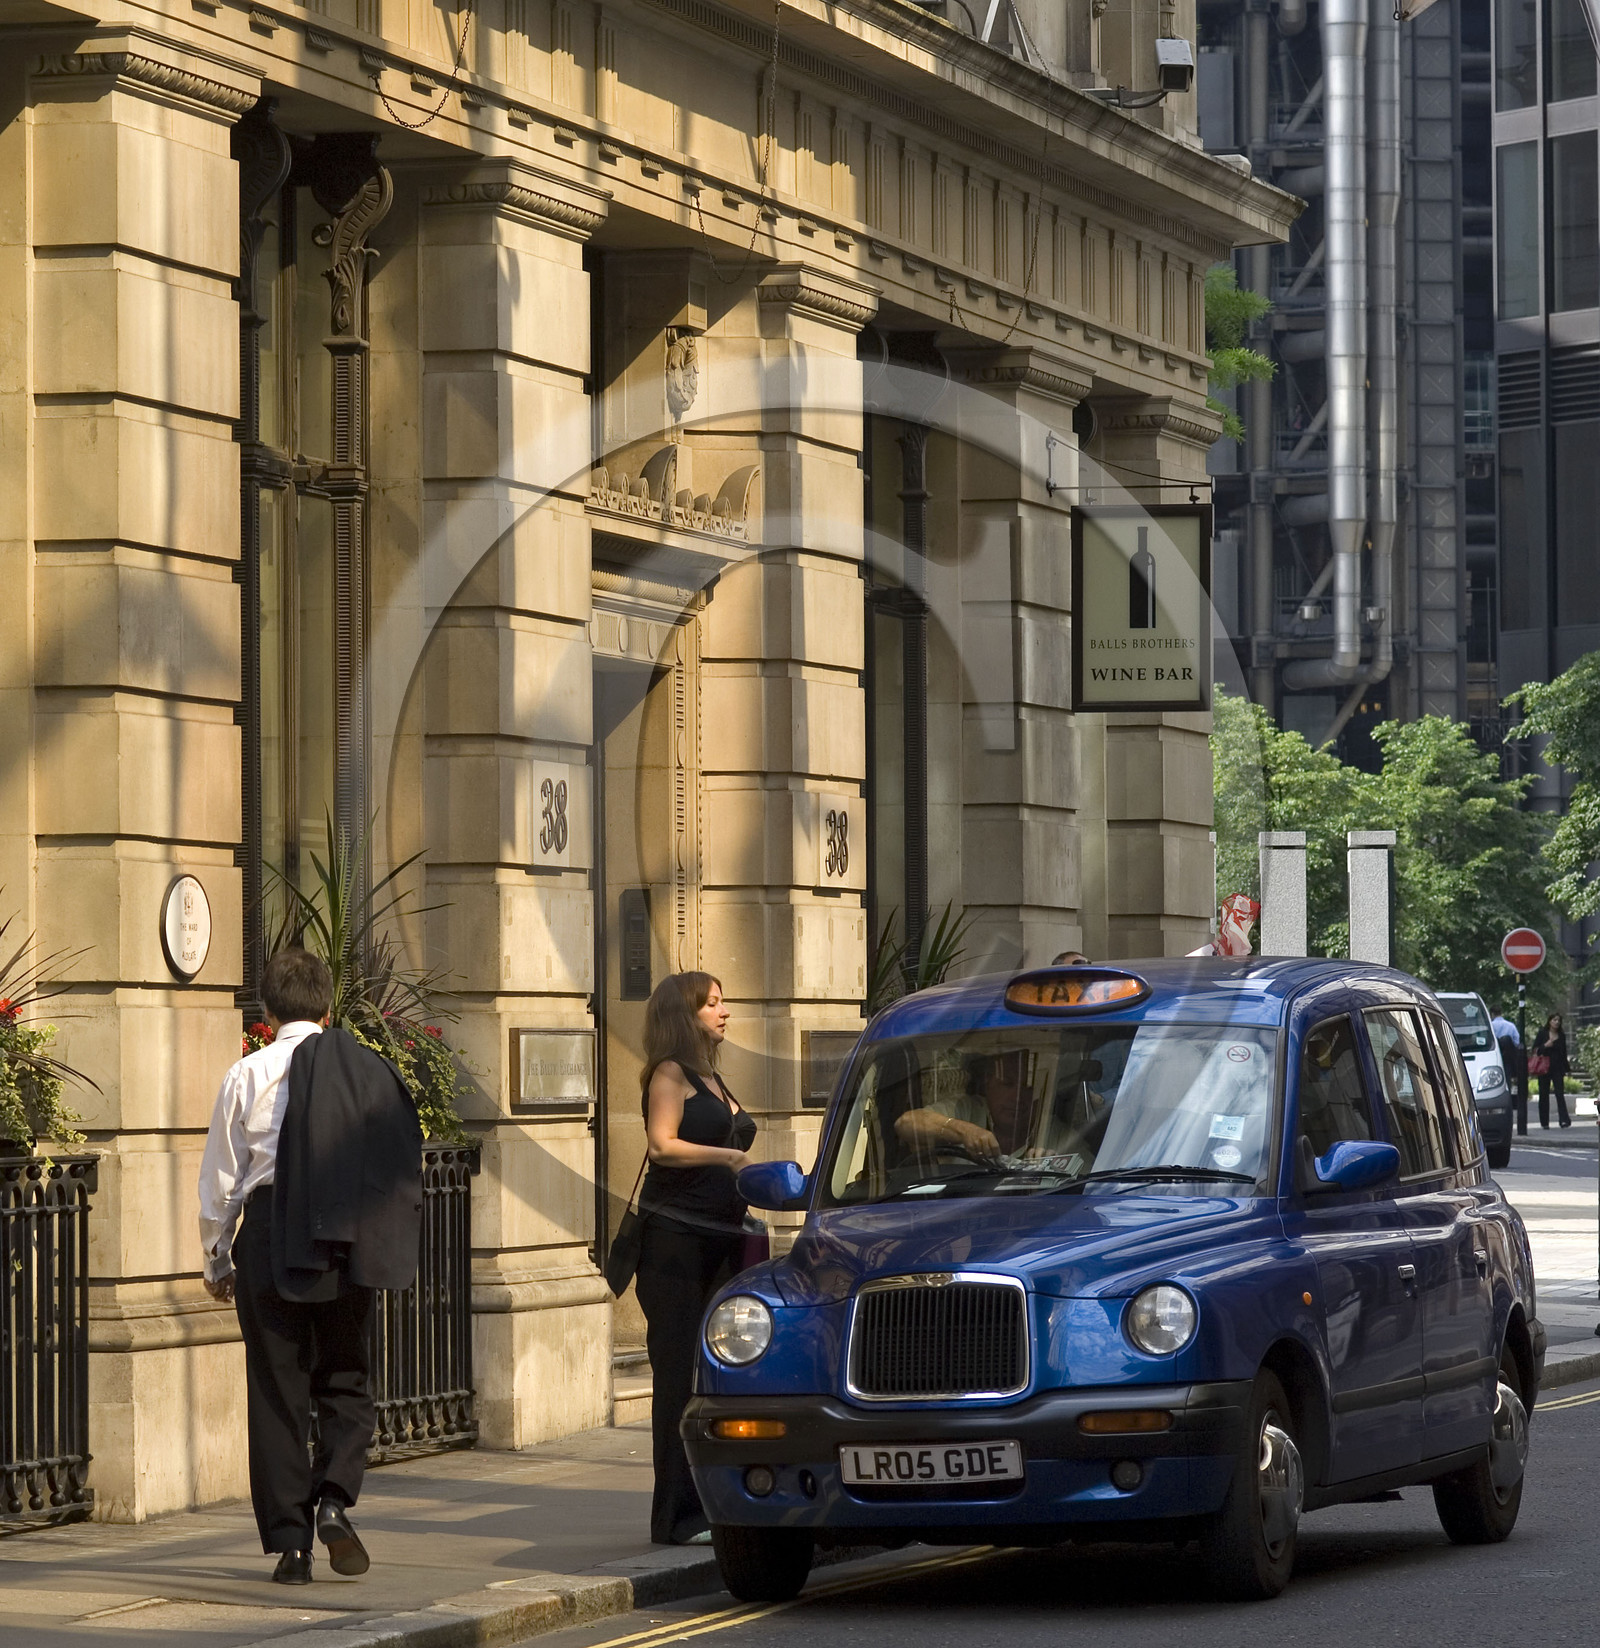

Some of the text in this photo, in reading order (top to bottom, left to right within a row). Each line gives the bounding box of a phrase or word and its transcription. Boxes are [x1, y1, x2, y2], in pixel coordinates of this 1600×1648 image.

[1091, 639, 1195, 649] BALLS BROTHERS
[1091, 668, 1194, 681] WINE BAR
[540, 777, 568, 854] 38
[825, 809, 849, 877] 38
[188, 923, 198, 931] WARD
[1033, 979, 1112, 1003] TAXI
[854, 1446, 1009, 1480] LR05 GDE
